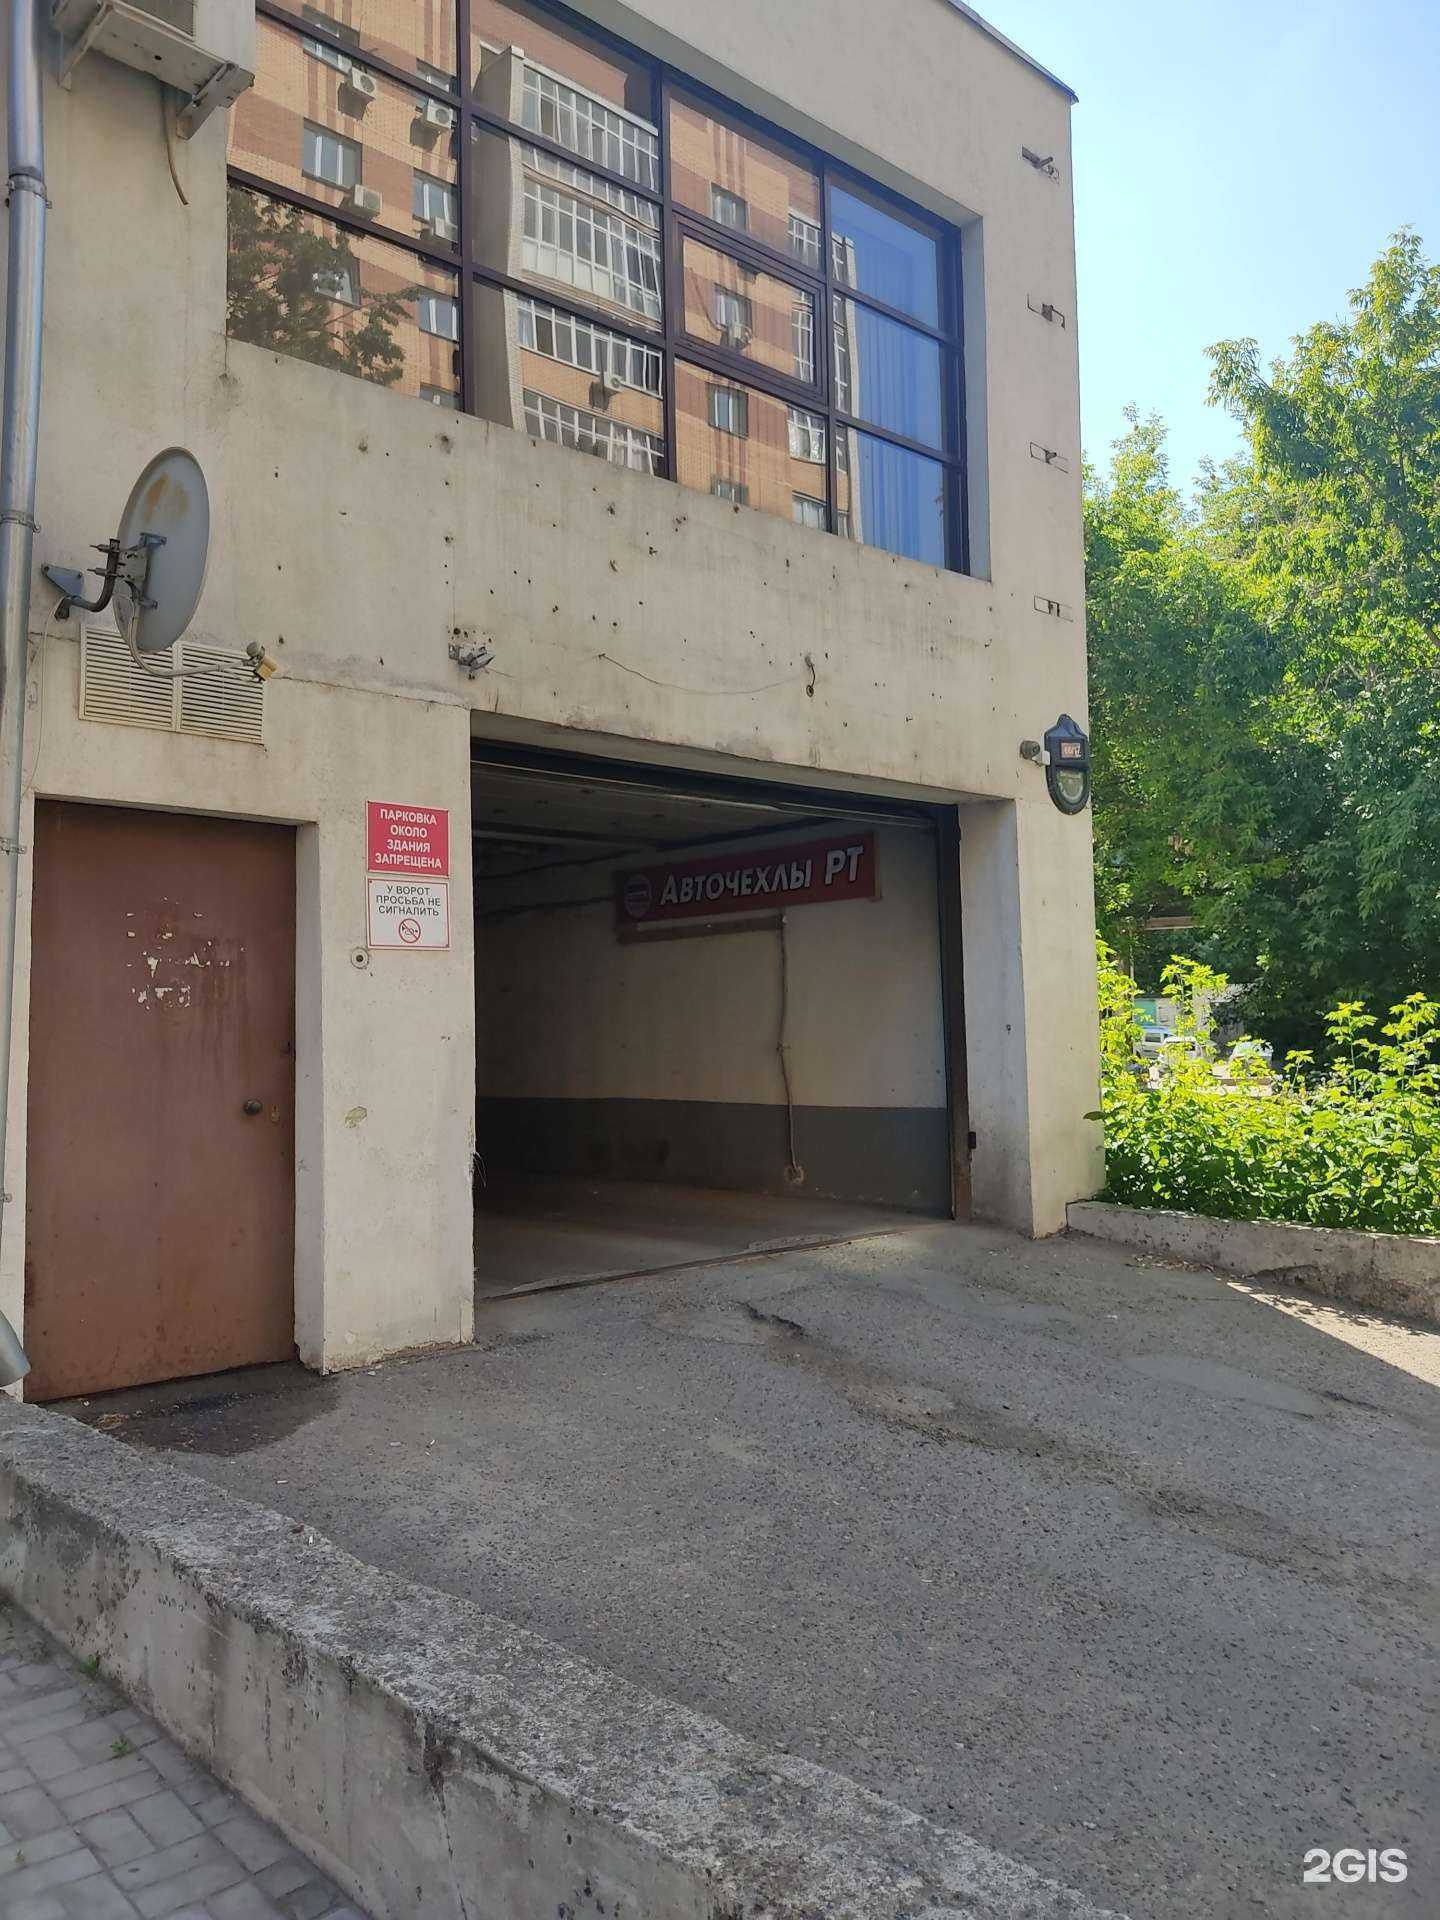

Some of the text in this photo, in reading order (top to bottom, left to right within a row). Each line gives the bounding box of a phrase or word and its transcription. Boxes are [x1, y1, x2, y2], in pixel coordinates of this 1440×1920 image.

[380, 808, 437, 825] ПАРКОВКА
[390, 824, 428, 839] ОКОЛО
[387, 839, 431, 853] ЗДАНИЯ
[375, 852, 442, 869] ЗАПРЕЩЕНА
[660, 859, 813, 905] АВТОЧЕХЛЫ
[824, 845, 864, 885] РТ
[387, 885, 431, 896] У ВОРОТ
[376, 895, 441, 907] ПРОСЬБА НЕ
[378, 905, 440, 917] СИГНАЛИТЬ
